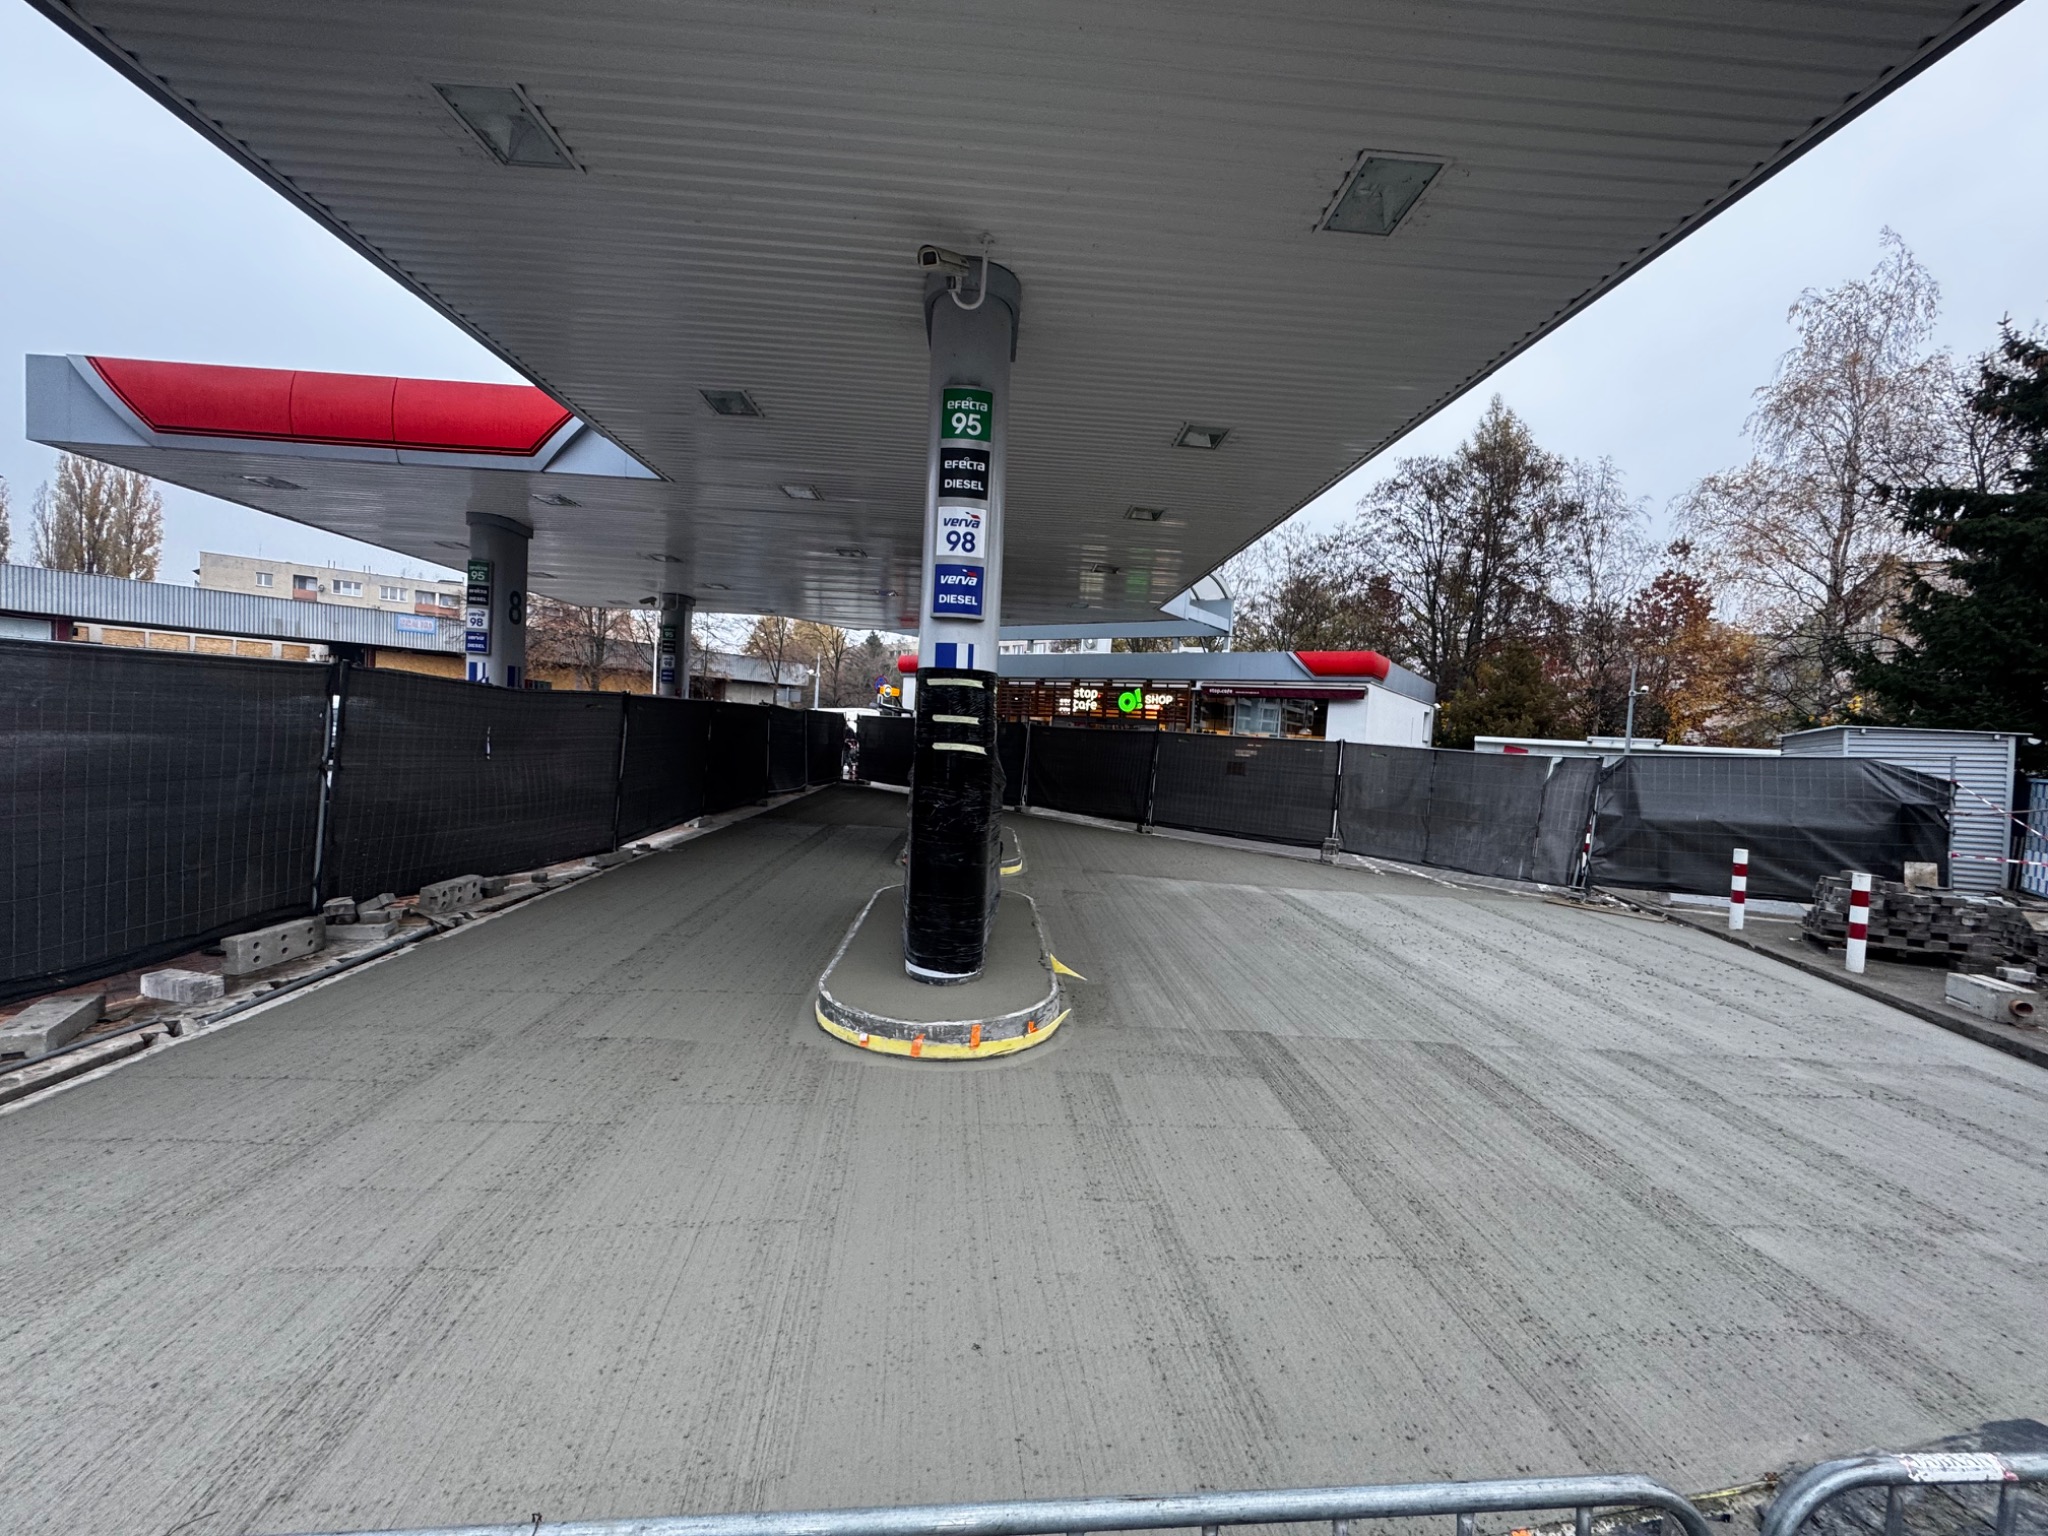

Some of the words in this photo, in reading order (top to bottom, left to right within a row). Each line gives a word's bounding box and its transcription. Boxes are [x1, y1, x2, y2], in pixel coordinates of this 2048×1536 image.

[947, 398, 988, 412] efecta
[951, 412, 982, 436] 95
[944, 458, 985, 472] efecta
[944, 479, 984, 491] DIESEL
[943, 517, 981, 529] verva
[946, 530, 975, 553] 98
[471, 570, 485, 580] 95
[940, 575, 977, 586] verva
[938, 594, 978, 606] DIESEL
[509, 590, 522, 625] 8
[469, 617, 484, 627] 98
[1072, 699, 1098, 712] cafe
[1144, 694, 1173, 705] SHOP
